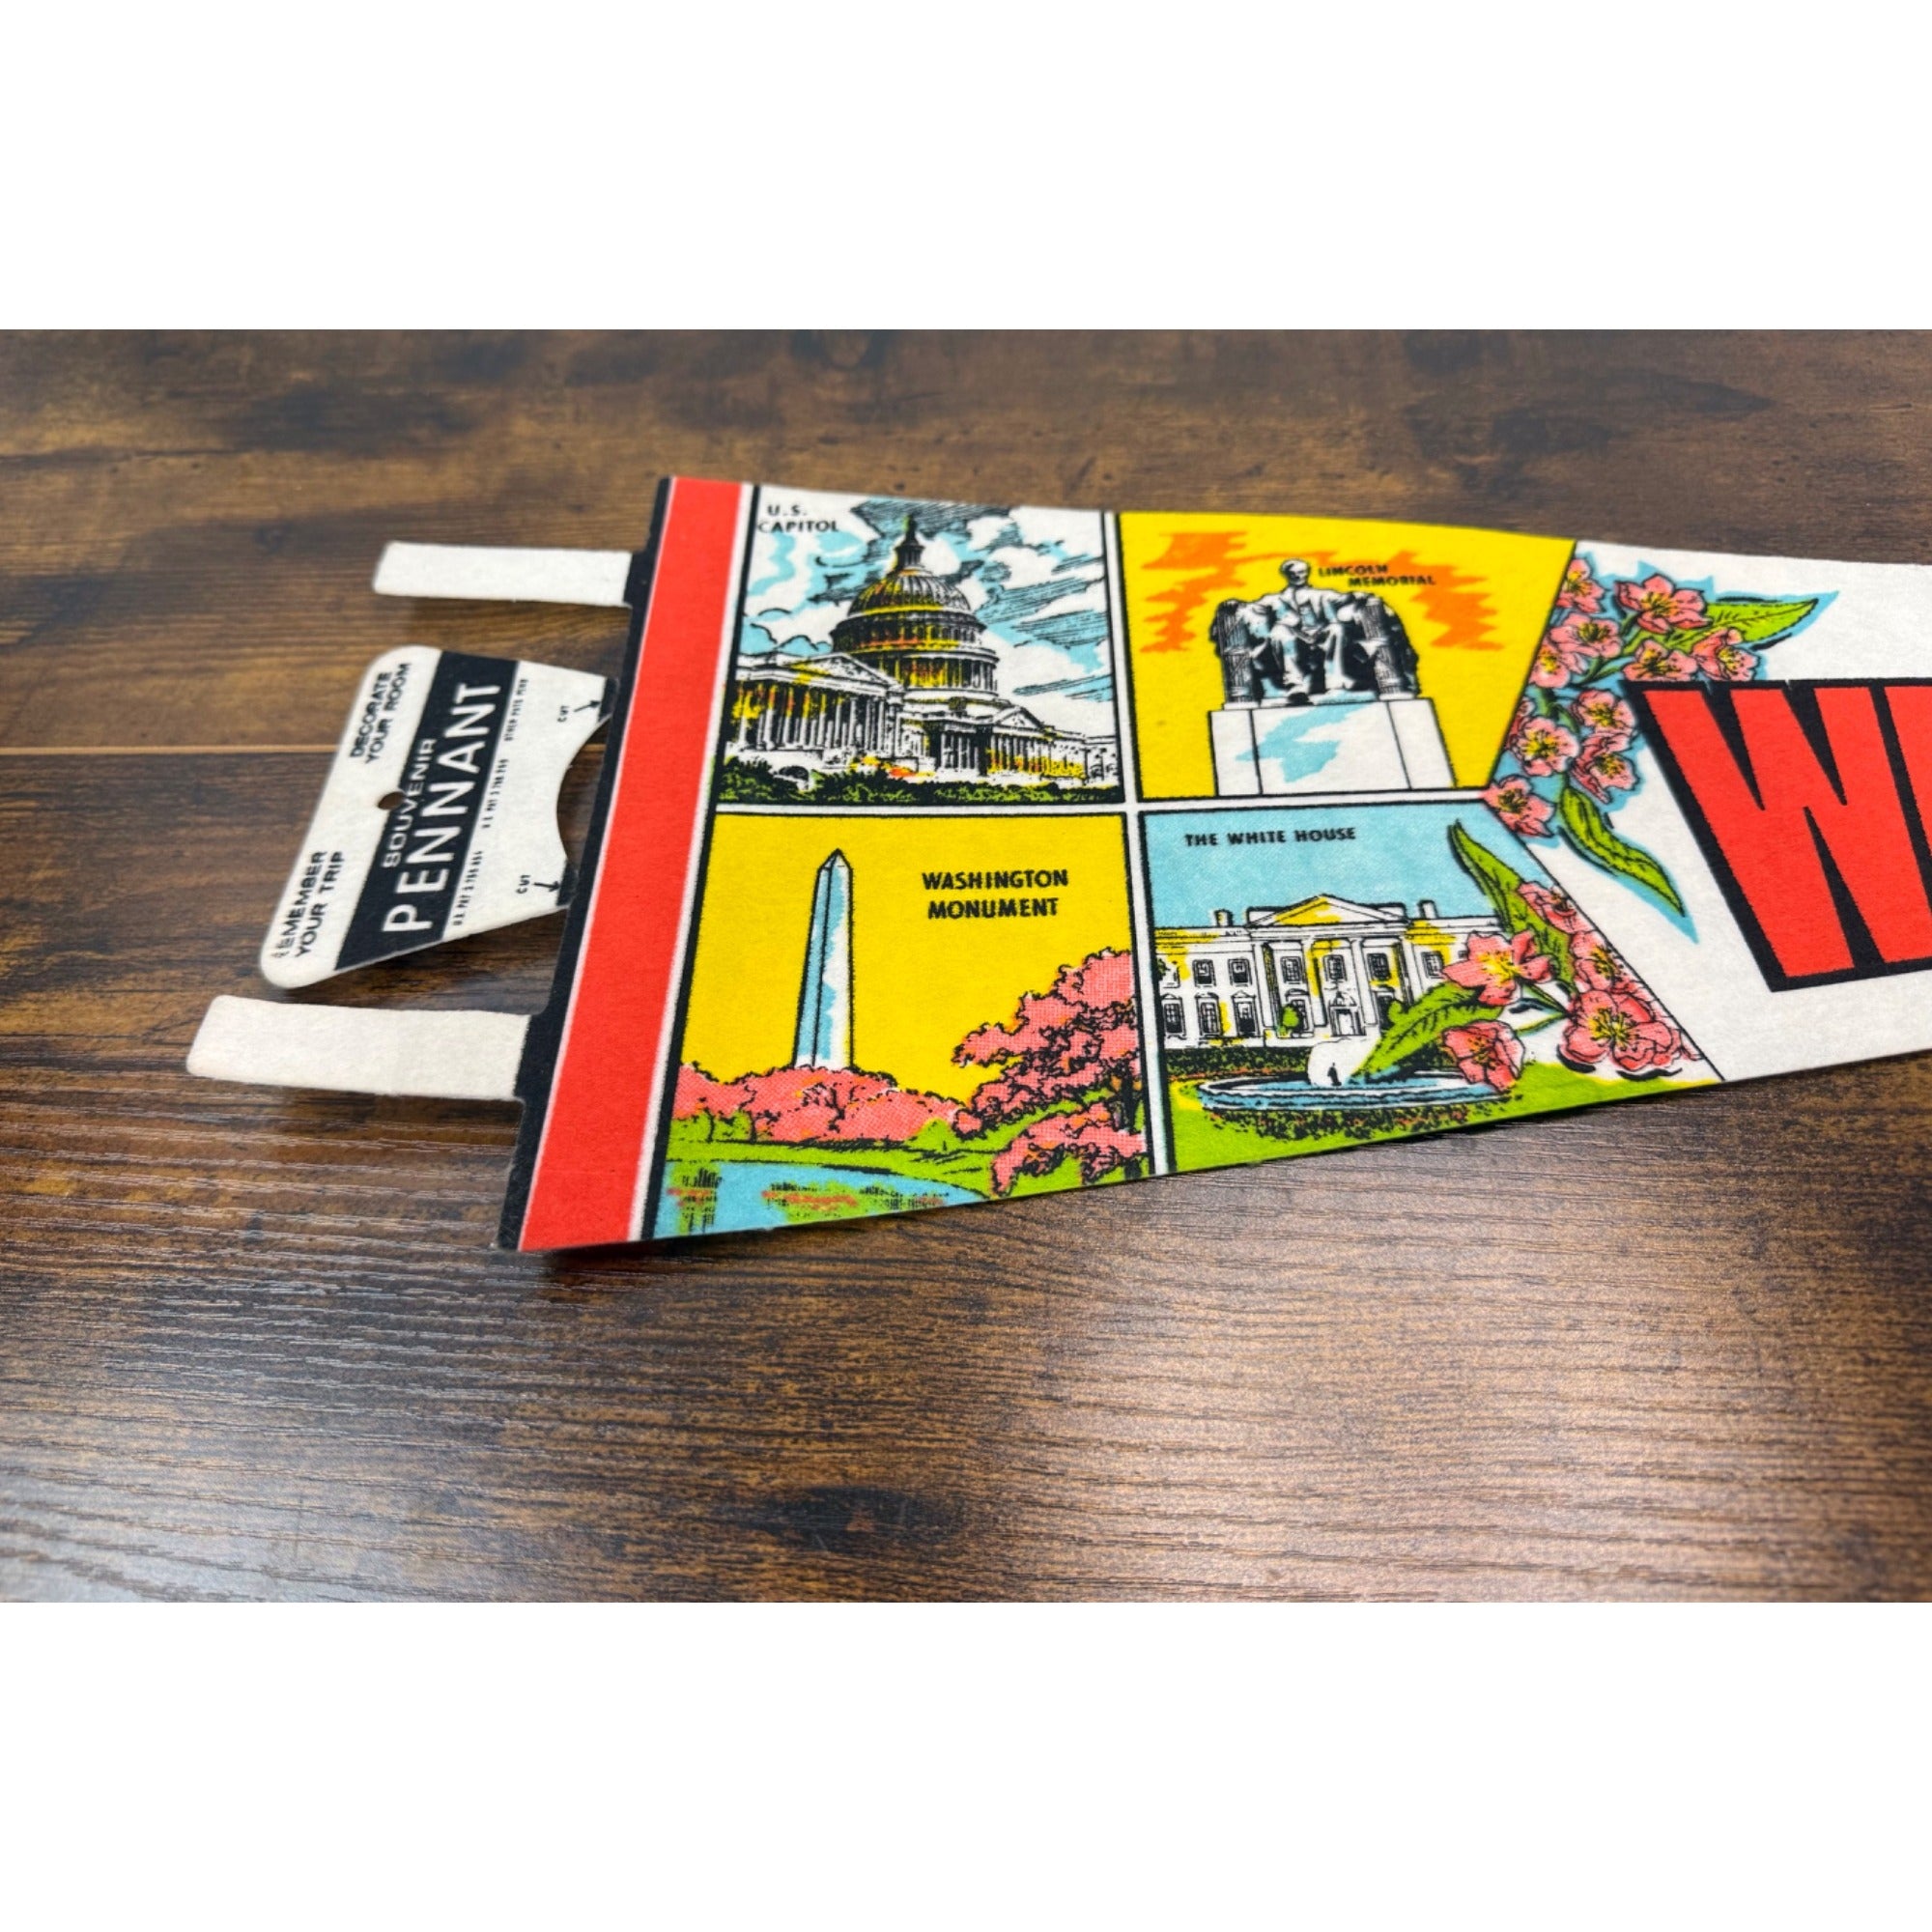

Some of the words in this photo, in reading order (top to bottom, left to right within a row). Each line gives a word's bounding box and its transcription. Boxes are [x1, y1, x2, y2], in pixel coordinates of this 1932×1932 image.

[766, 504, 809, 517] U.S.
[757, 520, 839, 532] CAPITOL
[1318, 564, 1389, 577] LINCOLN
[1348, 576, 1436, 587] MEMORIAL
[349, 671, 392, 757] DECORATE
[365, 719, 394, 764] YOUR
[384, 663, 412, 711] ROOM
[381, 738, 437, 867] SOUVENIR
[382, 682, 501, 932] PENNANT
[1184, 834, 1219, 847] THE
[1227, 830, 1287, 845] WHITE
[1294, 827, 1356, 842] HOUSE
[1617, 676, 1932, 992] W
[922, 868, 1069, 891] WASHINGTON
[295, 903, 328, 957] YOUR
[318, 851, 345, 895] TRIP
[927, 897, 1060, 920] MONUMENT
